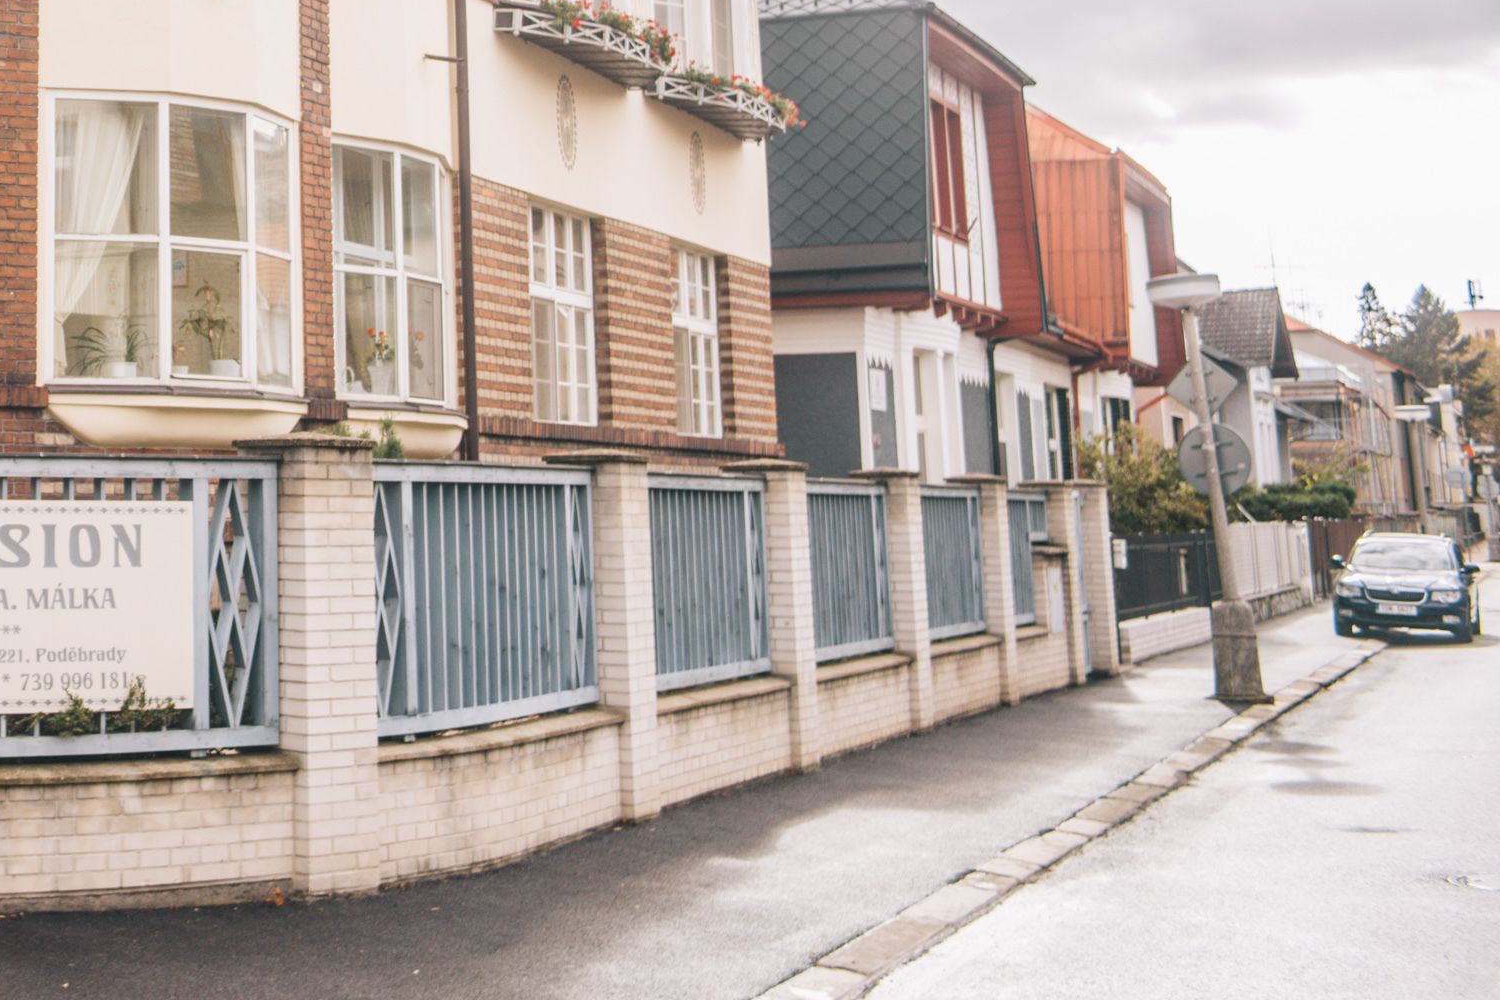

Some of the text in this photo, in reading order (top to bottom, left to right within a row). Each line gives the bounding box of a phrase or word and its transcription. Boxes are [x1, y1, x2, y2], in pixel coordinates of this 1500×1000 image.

[25, 582, 117, 610] MÁLKA
[35, 646, 127, 665] Poděbrady
[19, 672, 54, 692] 739
[60, 671, 94, 691] 996
[100, 671, 128, 690] 181
